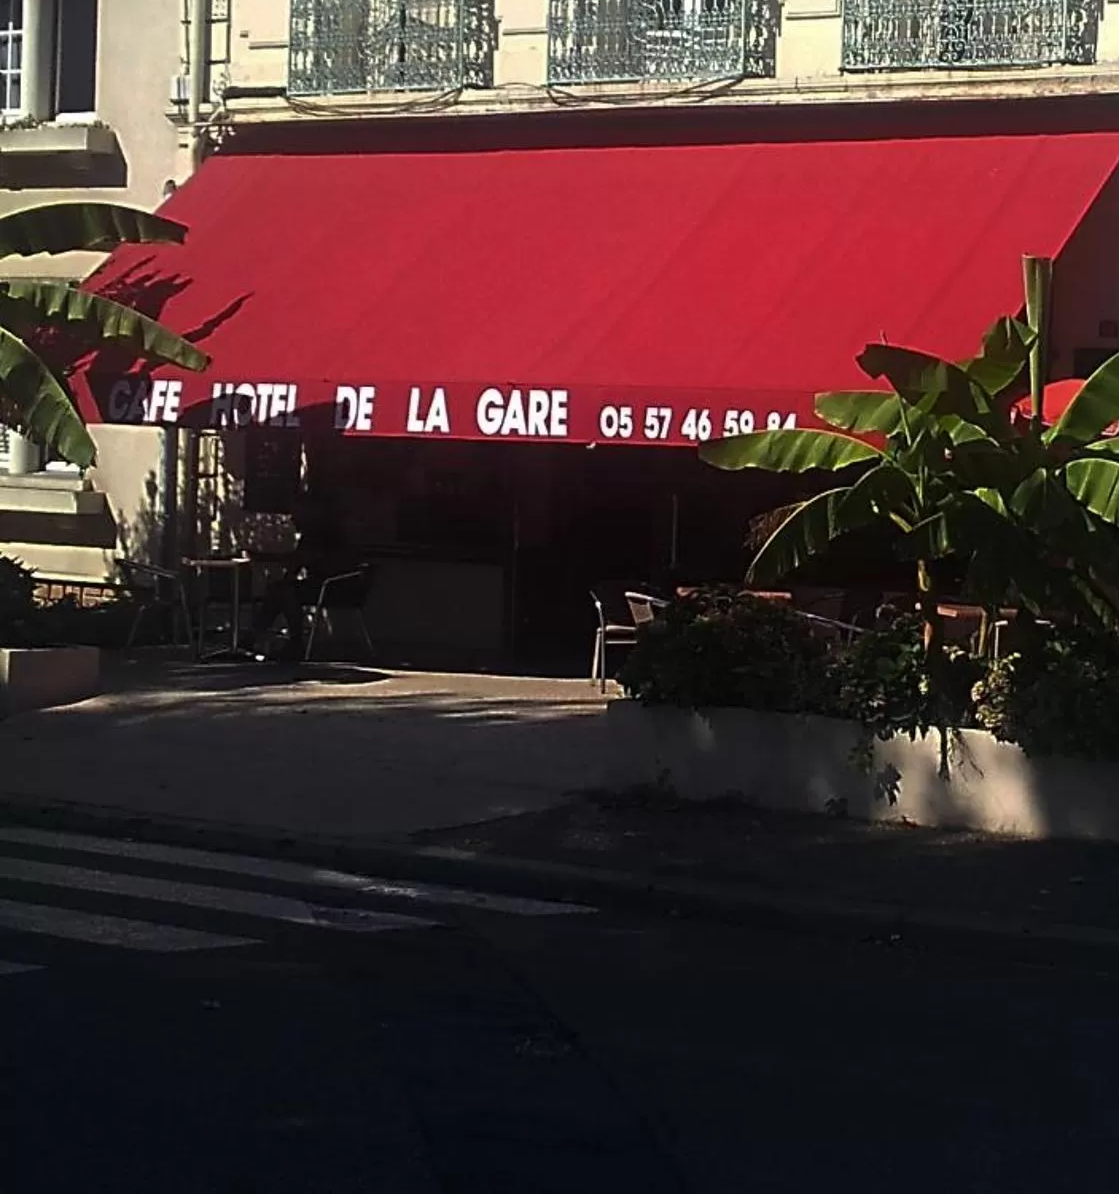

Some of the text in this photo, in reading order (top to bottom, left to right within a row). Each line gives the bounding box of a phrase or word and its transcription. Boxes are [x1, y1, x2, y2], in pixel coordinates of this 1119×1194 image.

[109, 379, 182, 424] CAFE
[210, 382, 298, 429] HOTEL
[334, 385, 376, 431] DE
[406, 386, 450, 433] LA
[476, 388, 568, 437] GARE
[600, 405, 633, 438] 05
[644, 407, 673, 439] 57
[680, 408, 712, 442] 46
